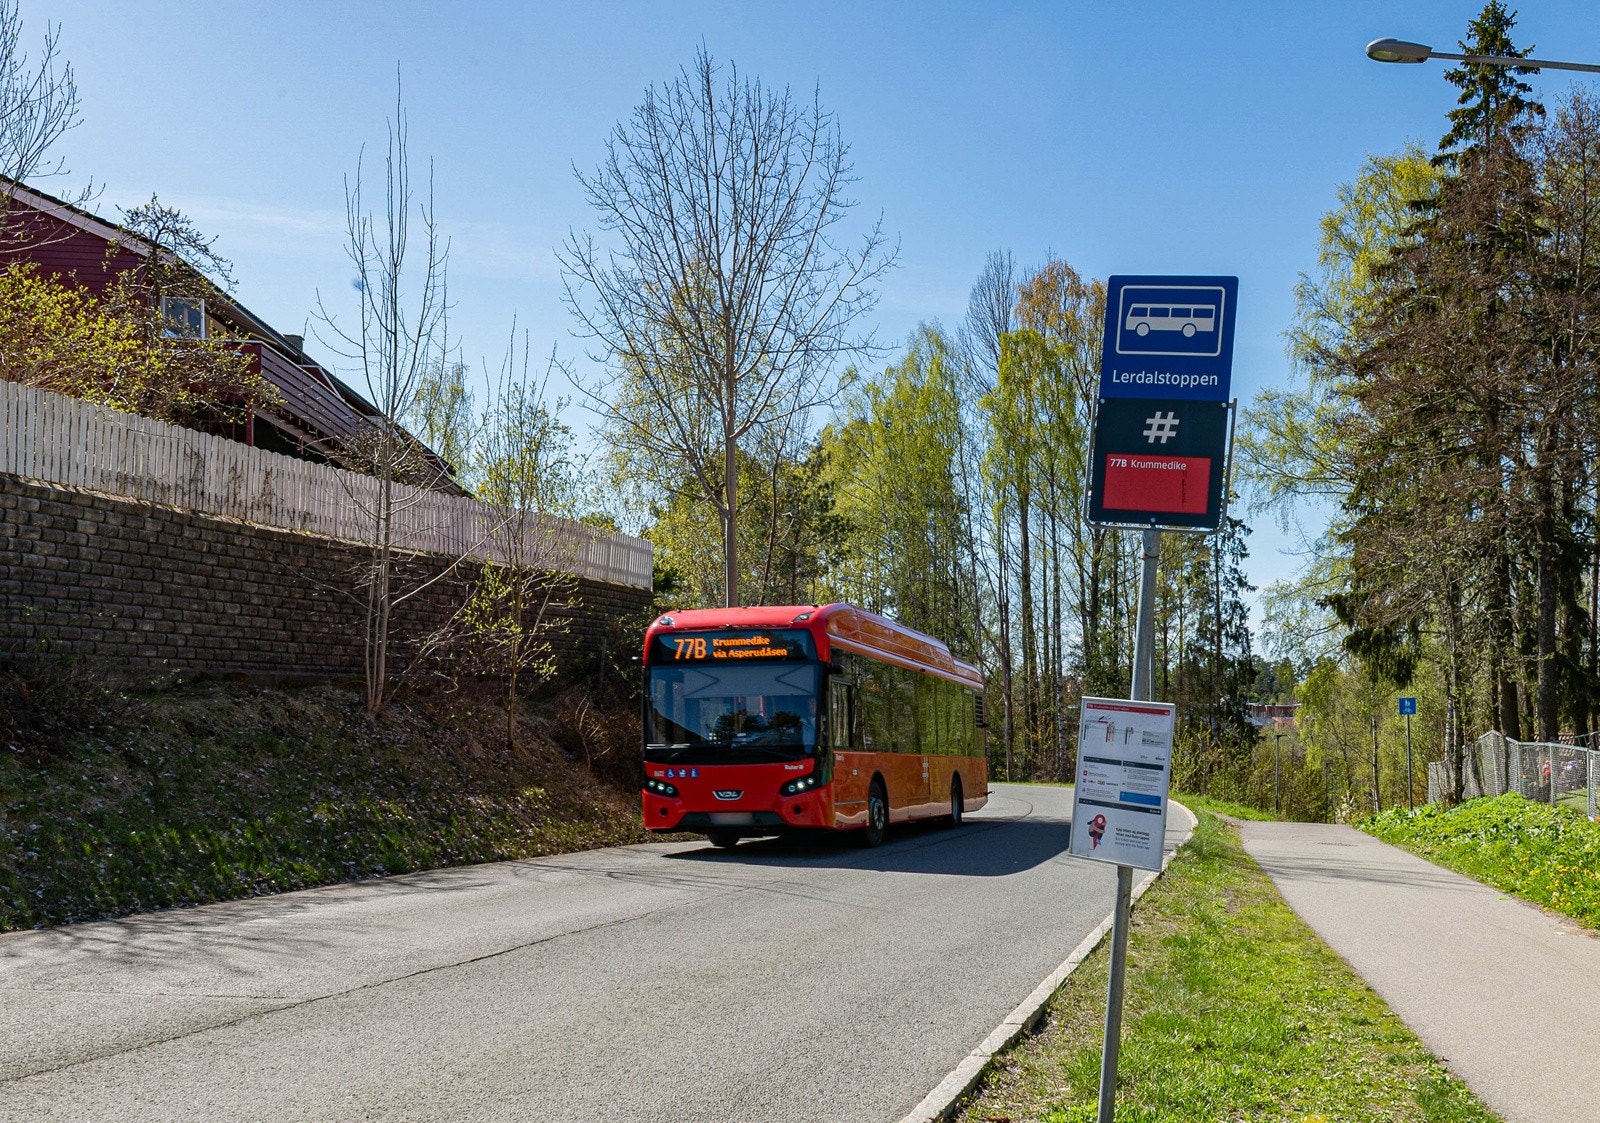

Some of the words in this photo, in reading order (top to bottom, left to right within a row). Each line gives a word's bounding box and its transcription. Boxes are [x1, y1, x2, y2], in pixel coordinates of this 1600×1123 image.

[1112, 369, 1218, 388] Lerdalstoppen
[1110, 458, 1127, 468] 77B
[1131, 458, 1187, 471] Krummedike
[712, 635, 771, 647] Krummedike
[674, 637, 707, 660] 77B
[712, 650, 728, 659] via
[728, 646, 788, 659] Asperudåsen
